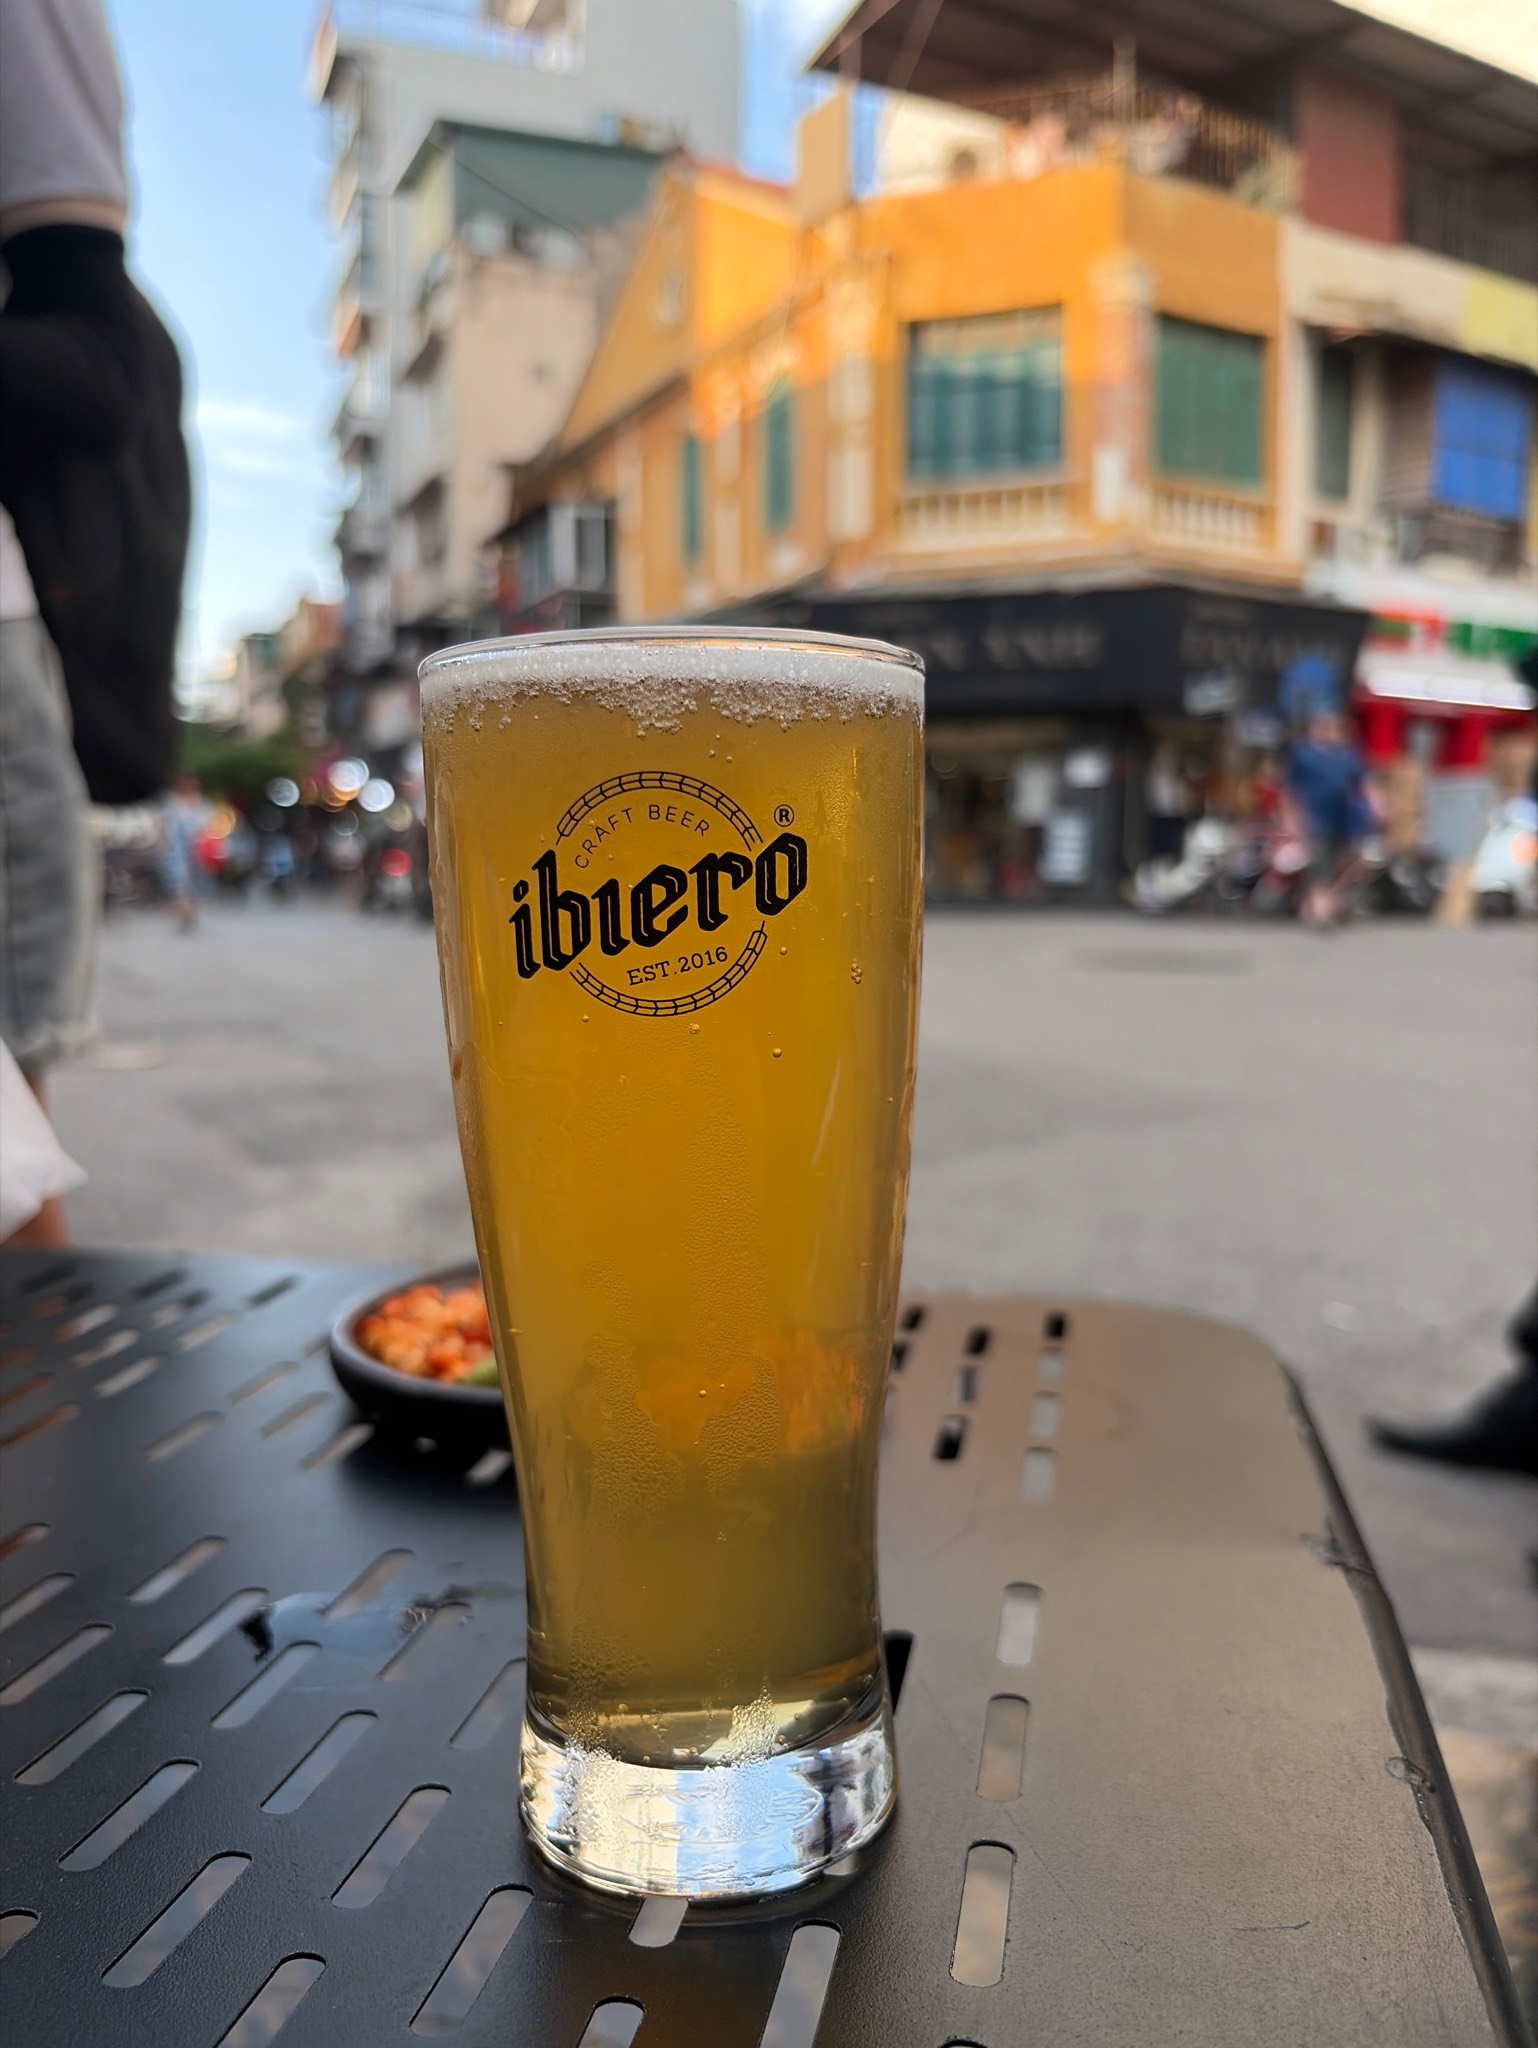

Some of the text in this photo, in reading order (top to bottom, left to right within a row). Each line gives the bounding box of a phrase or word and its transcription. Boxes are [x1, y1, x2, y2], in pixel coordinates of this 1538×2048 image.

[574, 804, 710, 869] CRAFT BEER
[509, 832, 808, 980] ibiero
[626, 946, 728, 986] EST.2016
